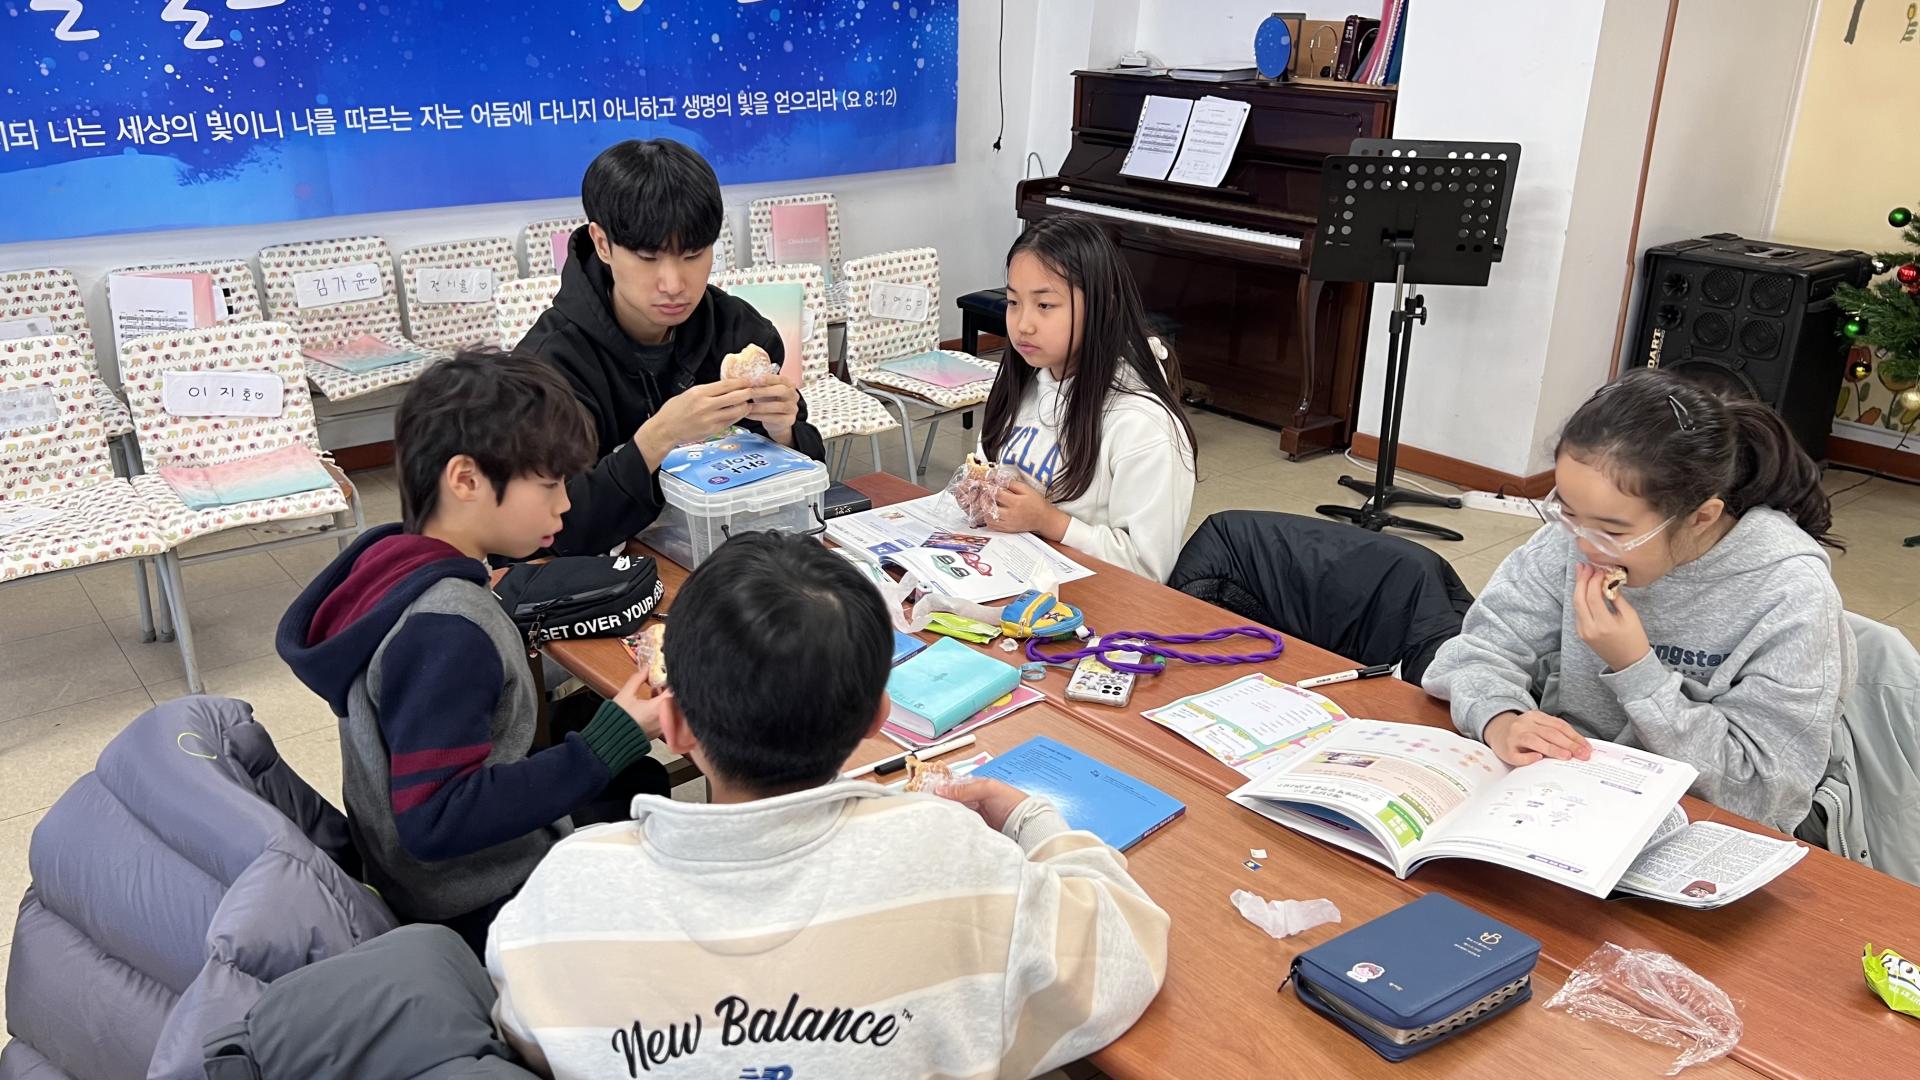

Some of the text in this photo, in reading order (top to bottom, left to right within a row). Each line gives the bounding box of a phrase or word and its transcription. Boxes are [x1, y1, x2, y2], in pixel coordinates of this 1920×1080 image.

[48, 117, 106, 149] 나는
[116, 113, 198, 145] 세상의
[205, 110, 284, 142] 빛이니
[291, 107, 337, 137] 나를
[344, 105, 413, 134] 따르는
[420, 103, 464, 130] 자는
[470, 100, 532, 128] 어둠에
[539, 98, 597, 125] 다니지
[603, 96, 677, 122] 아니하고
[682, 93, 732, 119] 생명의
[737, 91, 769, 116] 빛을
[774, 88, 838, 114] 얻으리라
[842, 90, 862, 111] (요
[865, 87, 897, 108] 8:12)
[539, 625, 570, 641] GET
[574, 614, 622, 636] OVER
[622, 596, 654, 623] YOUR
[611, 1013, 702, 1079] New
